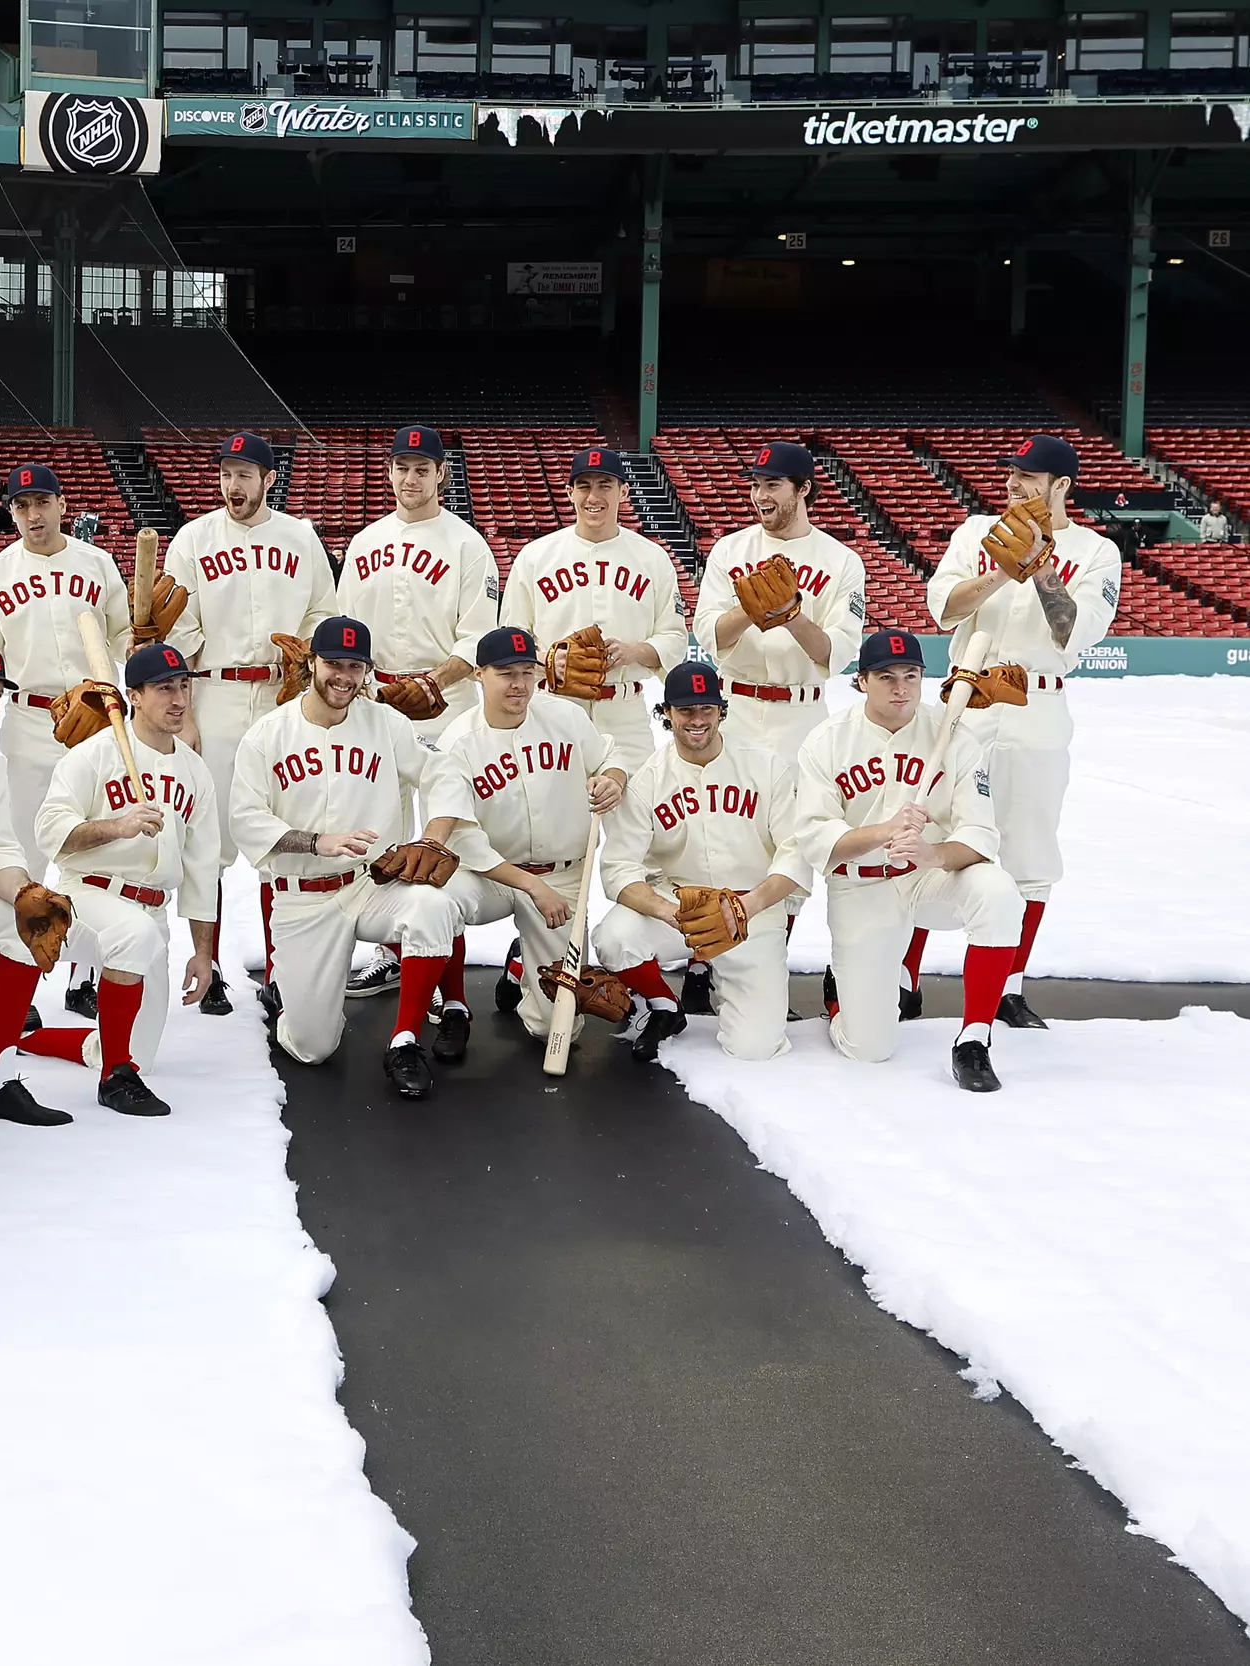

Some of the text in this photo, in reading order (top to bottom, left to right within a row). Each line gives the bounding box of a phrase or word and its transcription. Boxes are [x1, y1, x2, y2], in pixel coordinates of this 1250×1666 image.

[174, 110, 236, 124] DISCOVER
[244, 109, 264, 128] NHL
[268, 101, 371, 138] Winter
[374, 111, 464, 129] CLASSIC
[79, 117, 113, 150] NHL
[802, 111, 1025, 145] ticketmaster
[340, 239, 354, 251] 24
[790, 235, 804, 248] 25
[1213, 232, 1227, 245] 26
[229, 435, 247, 452] B
[407, 431, 422, 448] B
[588, 451, 603, 467] B
[756, 448, 772, 465] B
[19, 469, 33, 487] B
[199, 545, 299, 582] BOSTON
[355, 542, 450, 586] BOSTON
[537, 561, 651, 603] BOSTON
[342, 627, 357, 648] B
[510, 633, 527, 653] B
[888, 635, 907, 655] B
[162, 648, 181, 668] B
[1086, 660, 1128, 670] UNION
[691, 673, 707, 694] B
[273, 744, 380, 792] BOSTON
[473, 742, 573, 800] BOSTON
[655, 784, 759, 832] BOSTON
